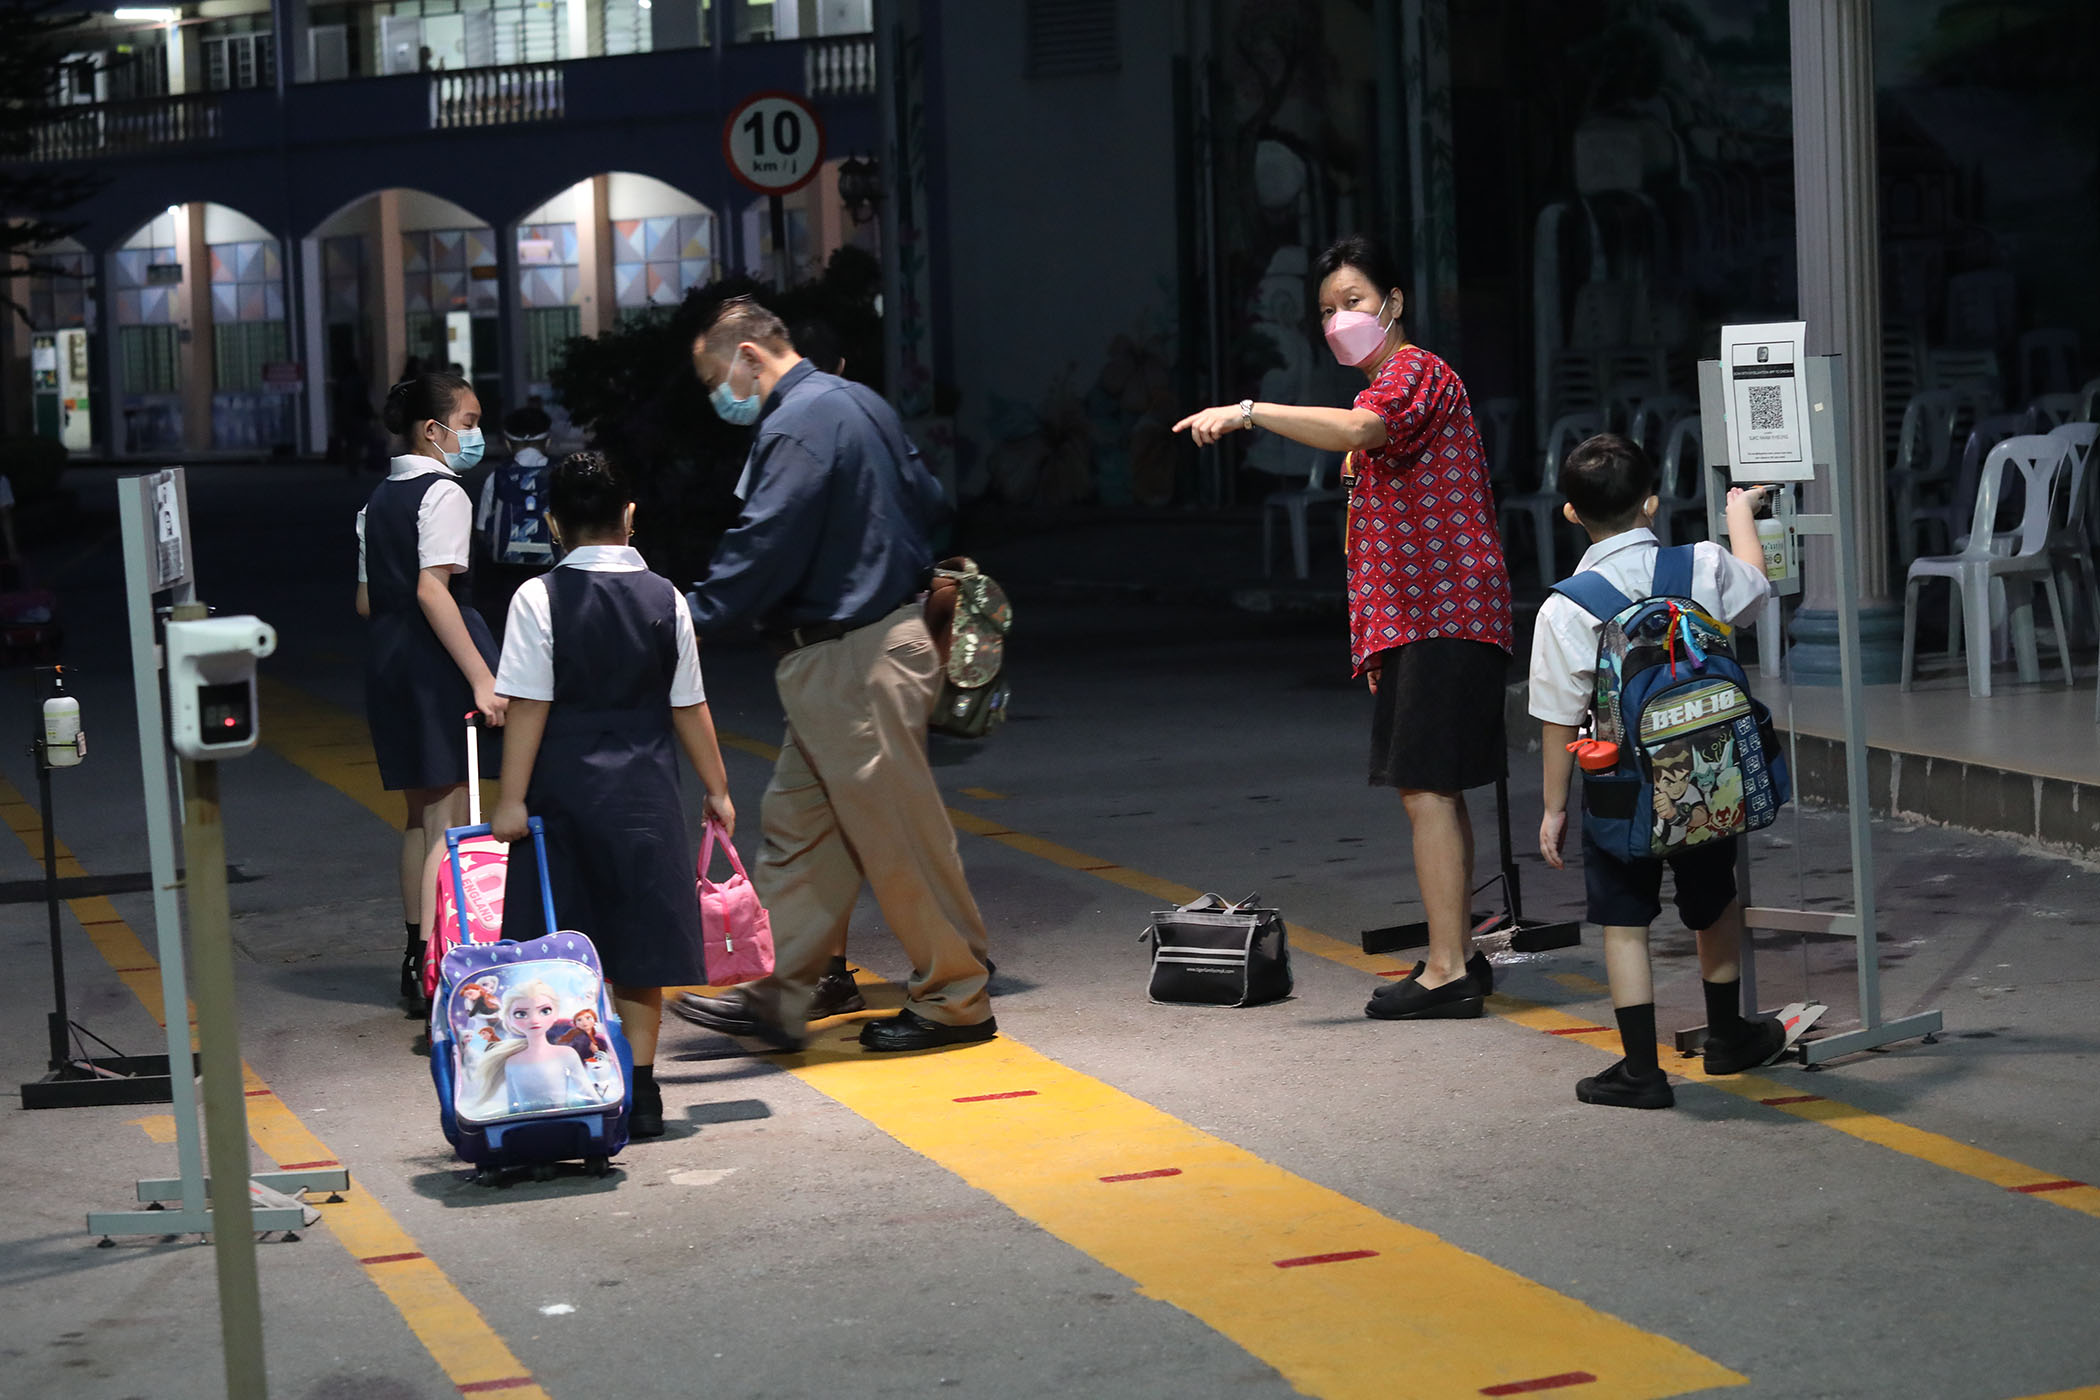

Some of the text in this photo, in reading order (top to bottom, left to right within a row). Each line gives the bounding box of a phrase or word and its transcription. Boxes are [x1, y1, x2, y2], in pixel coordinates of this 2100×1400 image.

[743, 109, 801, 156] 10
[1652, 700, 1704, 731] BEN
[1711, 689, 1736, 713] 10
[463, 878, 494, 922] ENGLAND
